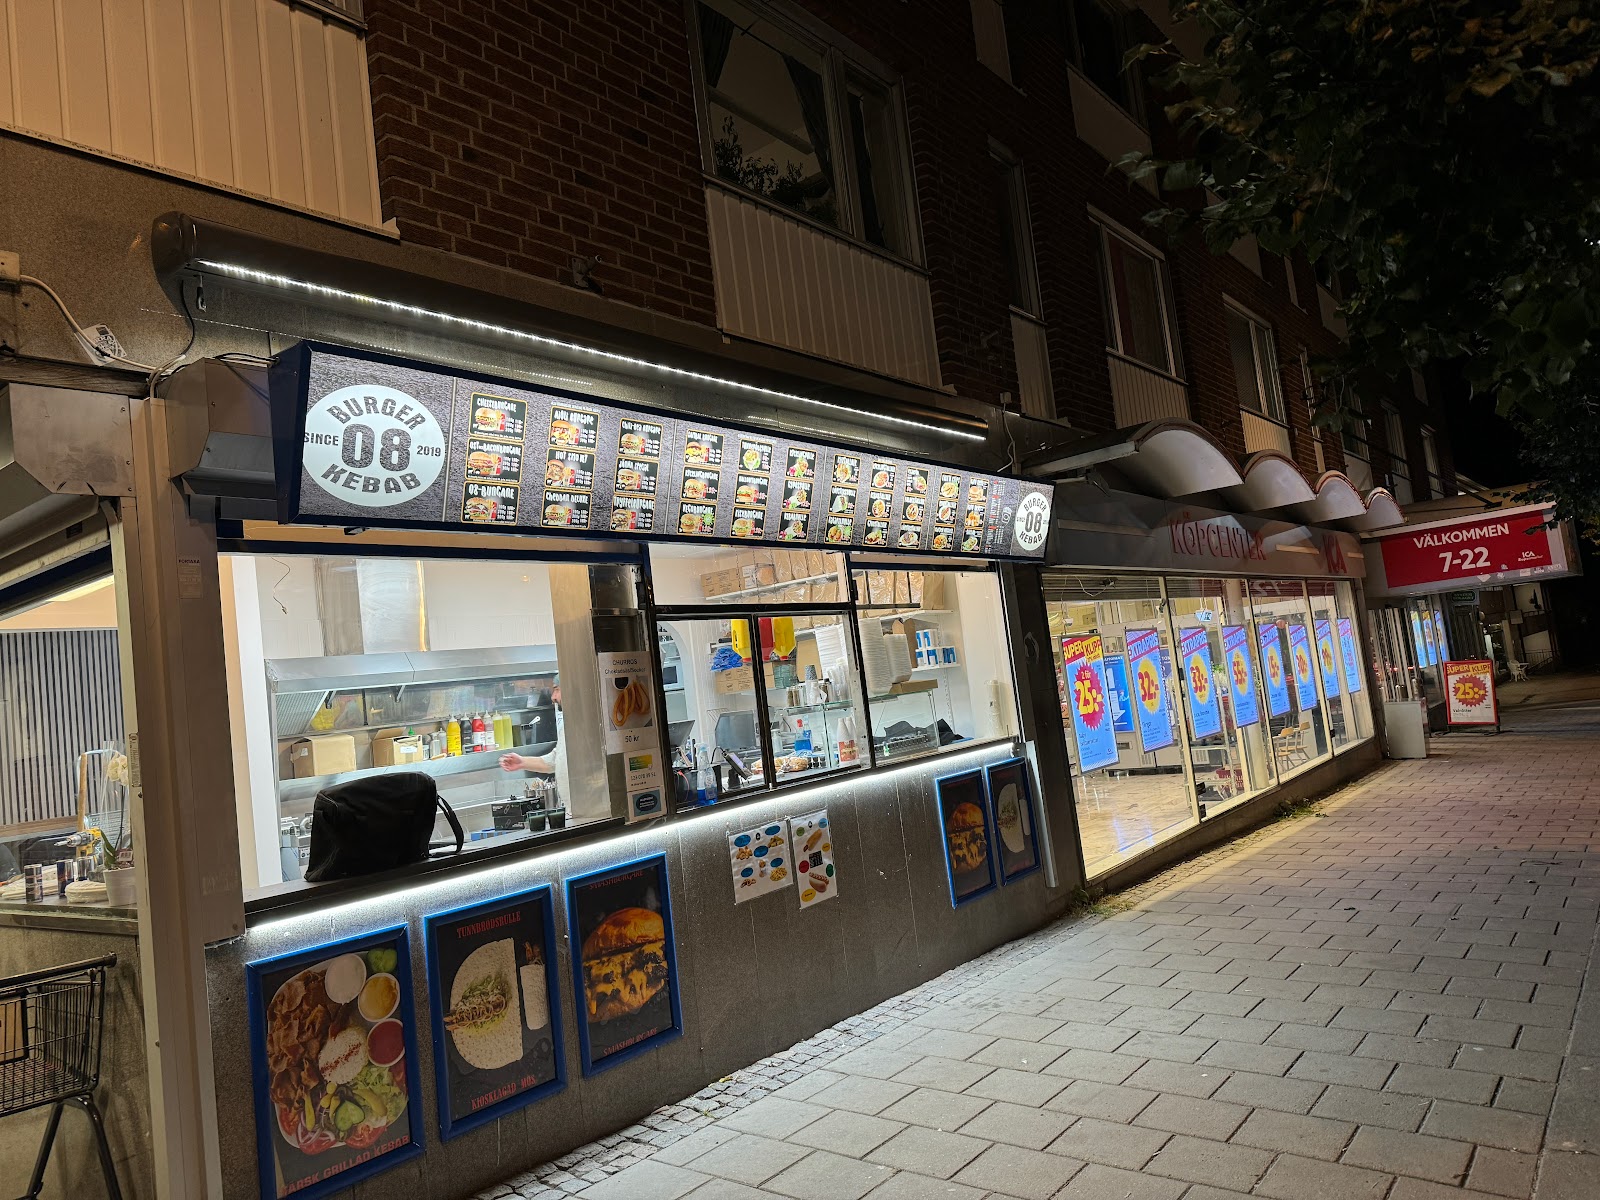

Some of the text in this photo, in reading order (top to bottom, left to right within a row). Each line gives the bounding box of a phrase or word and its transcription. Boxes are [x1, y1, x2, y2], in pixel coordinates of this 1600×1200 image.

[326, 395, 426, 430] BURGER
[304, 432, 339, 446] SINCE
[341, 423, 412, 472] 08
[416, 445, 442, 457] 2019
[320, 463, 421, 494] KEBAB
[1024, 497, 1047, 513] BURGER
[1025, 511, 1043, 534] 08
[1020, 531, 1043, 545] KEBAB
[1413, 522, 1510, 549] VÄLKOMMEN
[1438, 546, 1491, 573] 7-22
[1521, 551, 1536, 559] ICA
[1063, 640, 1083, 660] SUPER
[1190, 665, 1208, 694] 33:-
[1447, 664, 1470, 674] SUPER
[1074, 680, 1103, 715] 25:-
[1137, 671, 1160, 703] 32:-
[1455, 683, 1485, 699] 25:-
[625, 734, 640, 743] 50 kr
[471, 1082, 517, 1111] KIOSKLAGAD
[323, 1151, 371, 1178] GRILLAD
[373, 1135, 410, 1157] KEBAB
